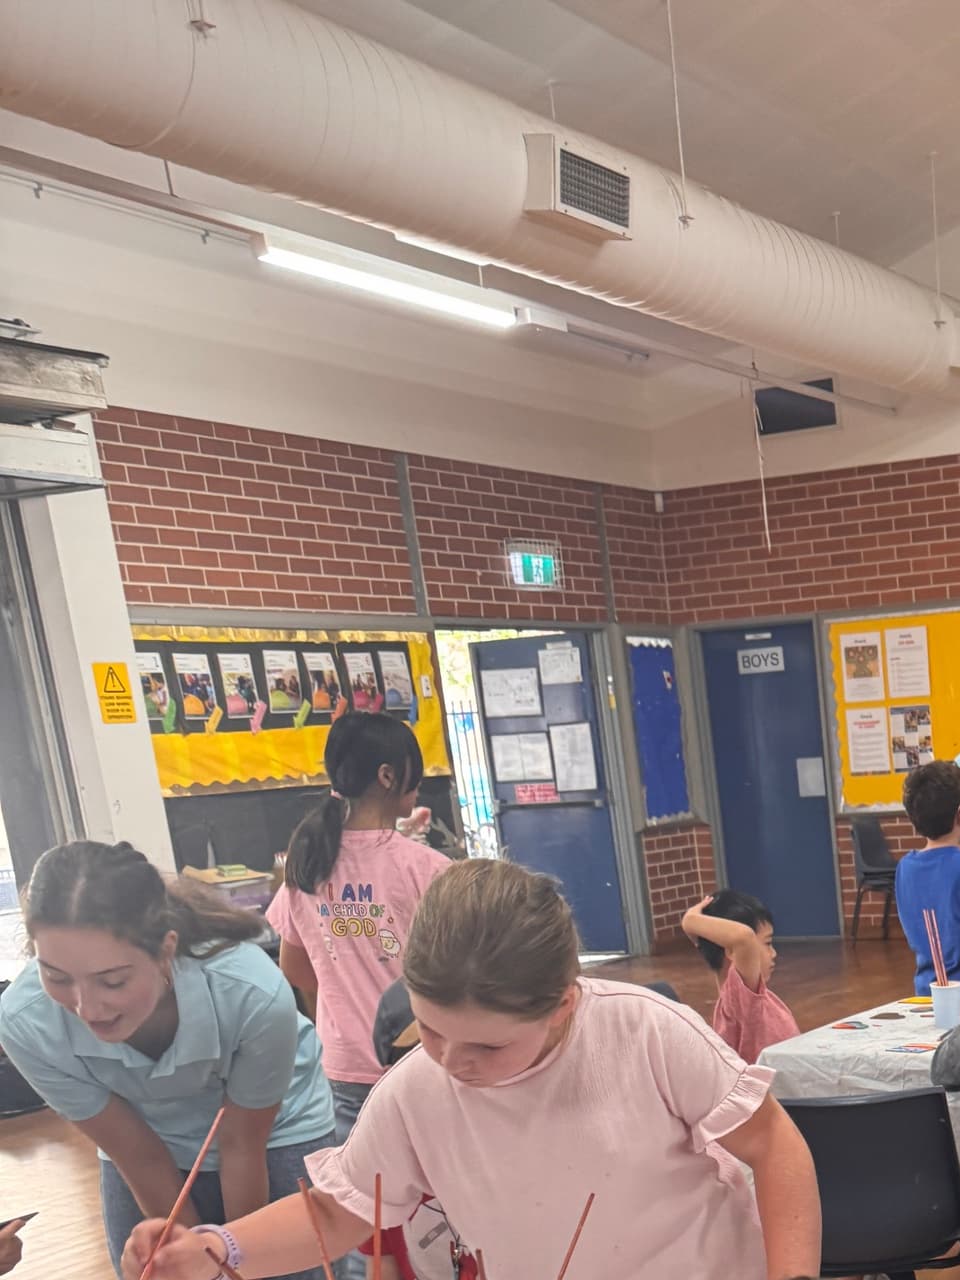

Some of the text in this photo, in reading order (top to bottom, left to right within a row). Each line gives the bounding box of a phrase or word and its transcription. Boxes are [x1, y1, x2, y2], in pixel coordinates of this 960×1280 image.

[741, 652, 780, 669] BOYS
[328, 883, 373, 903] I AM
[320, 903, 330, 917] A
[332, 903, 368, 918] CHILD
[331, 917, 377, 937] GOD
